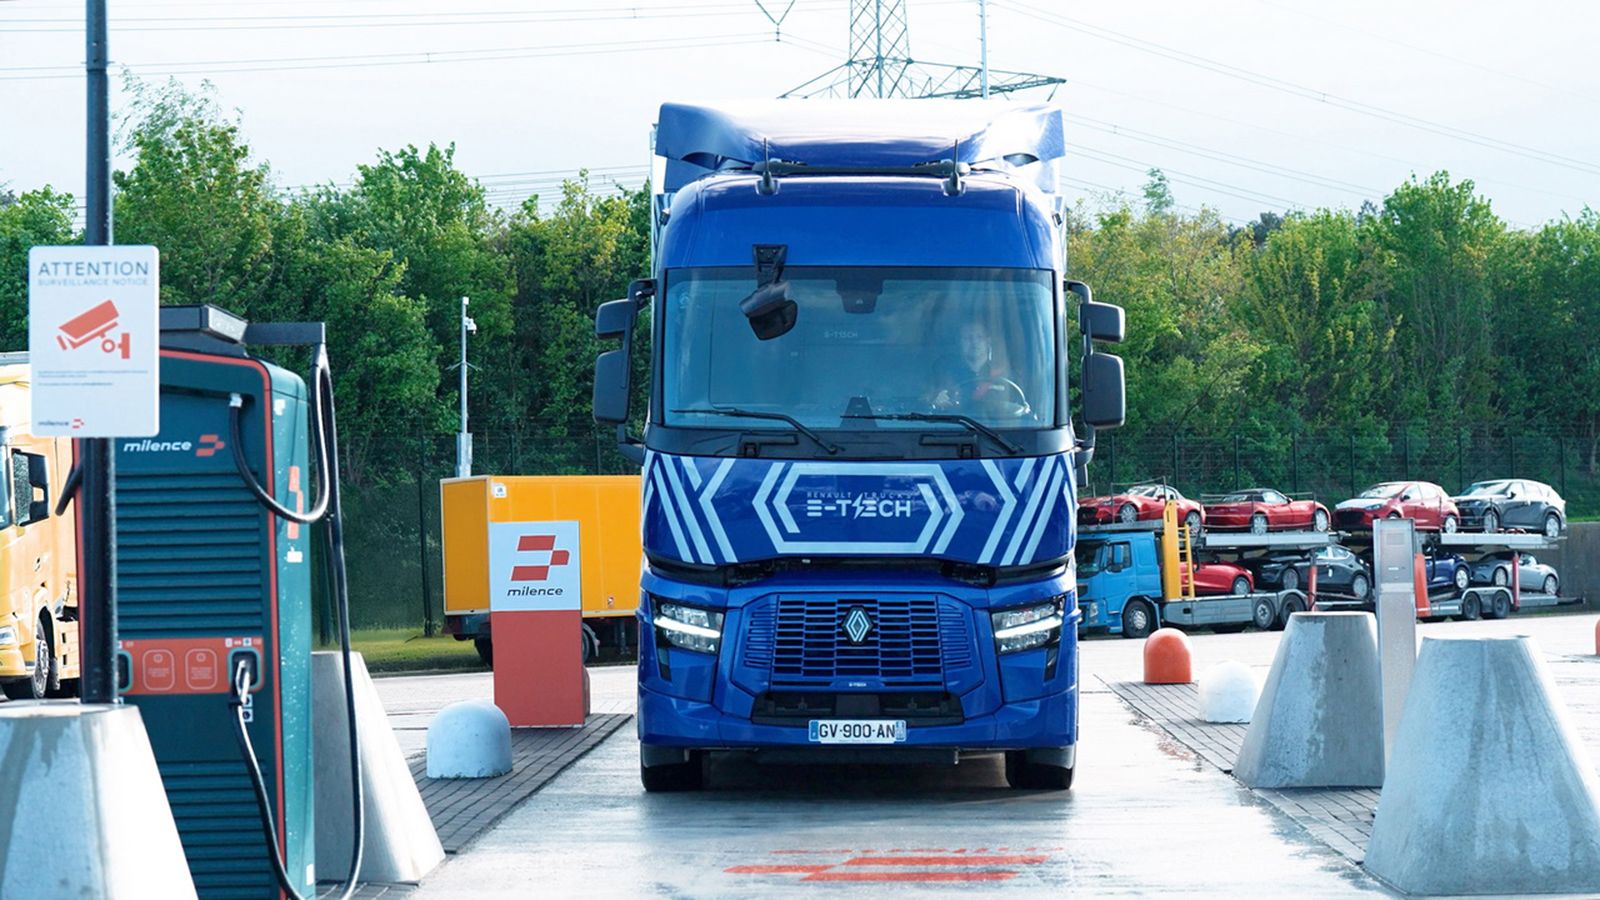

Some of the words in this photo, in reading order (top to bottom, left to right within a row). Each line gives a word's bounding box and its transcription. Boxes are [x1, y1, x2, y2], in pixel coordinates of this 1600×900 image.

[38, 261, 149, 276] ATTENTION
[37, 278, 108, 286] SURVEILLANCE
[112, 278, 149, 286] NOTICE
[123, 439, 192, 452] milence
[806, 491, 852, 499] RENAULT
[864, 491, 912, 499] TRUCKS
[806, 498, 911, 518] E-TECH
[507, 586, 564, 597] milence
[819, 724, 895, 738] GV-900-AN
